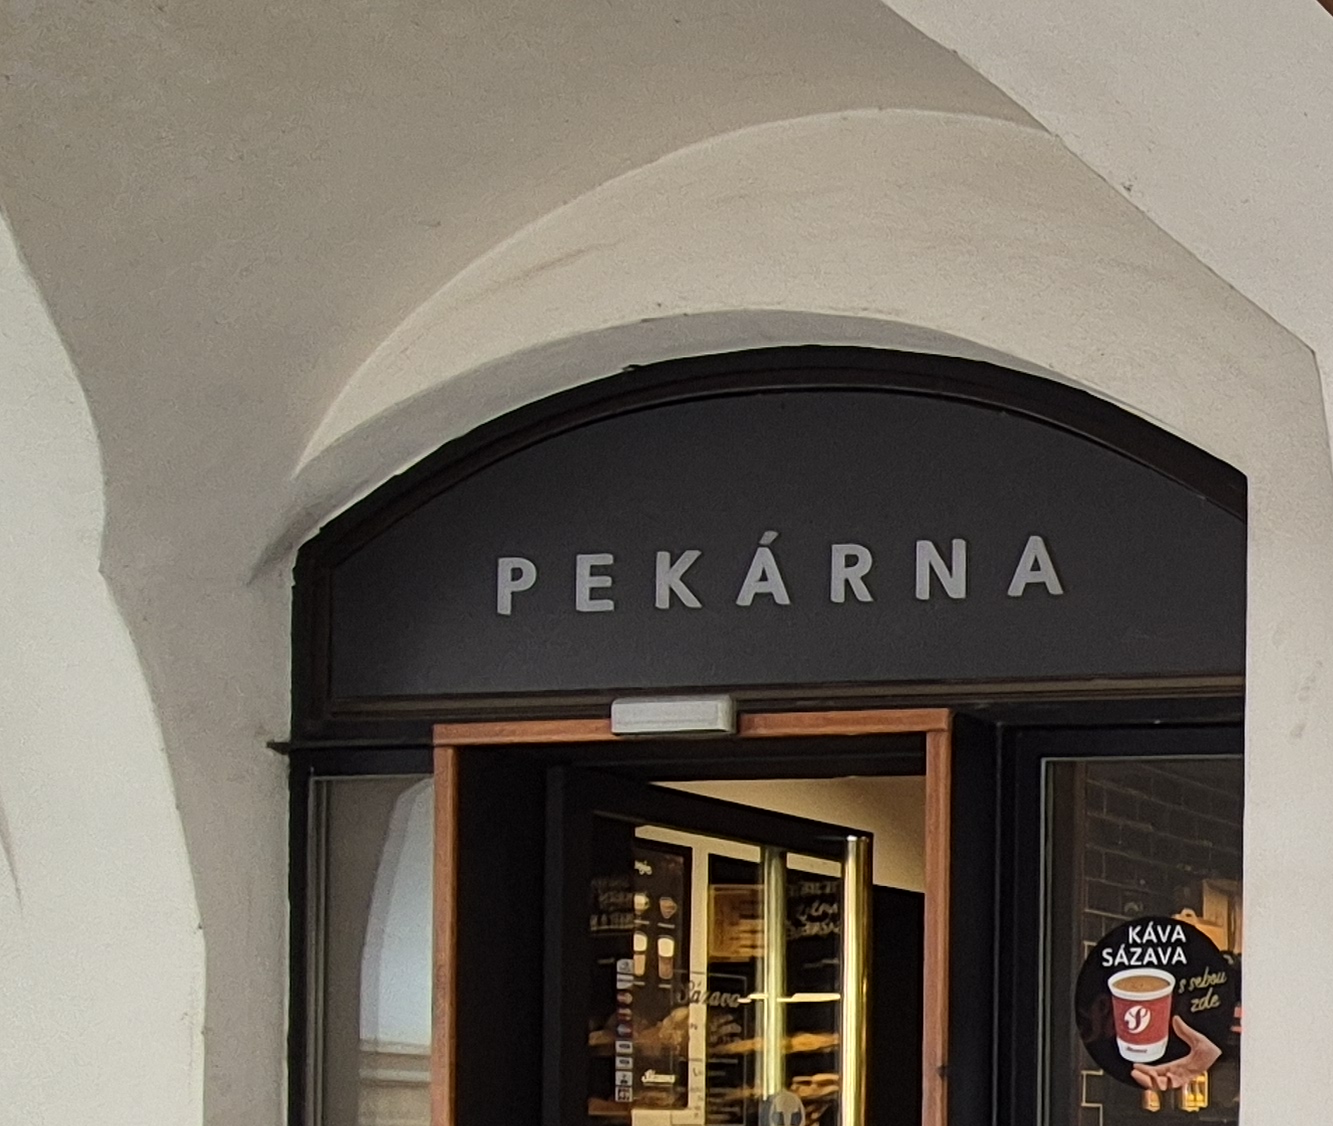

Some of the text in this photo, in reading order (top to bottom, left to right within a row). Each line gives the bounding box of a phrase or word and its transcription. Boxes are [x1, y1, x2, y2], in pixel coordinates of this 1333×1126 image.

[496, 530, 1065, 616] PEKÁRNA
[1128, 921, 1187, 944] KÁVA
[1101, 944, 1187, 967] SÁZAVA
[1178, 967, 1227, 993] s sebou
[1190, 988, 1222, 1013] zde
